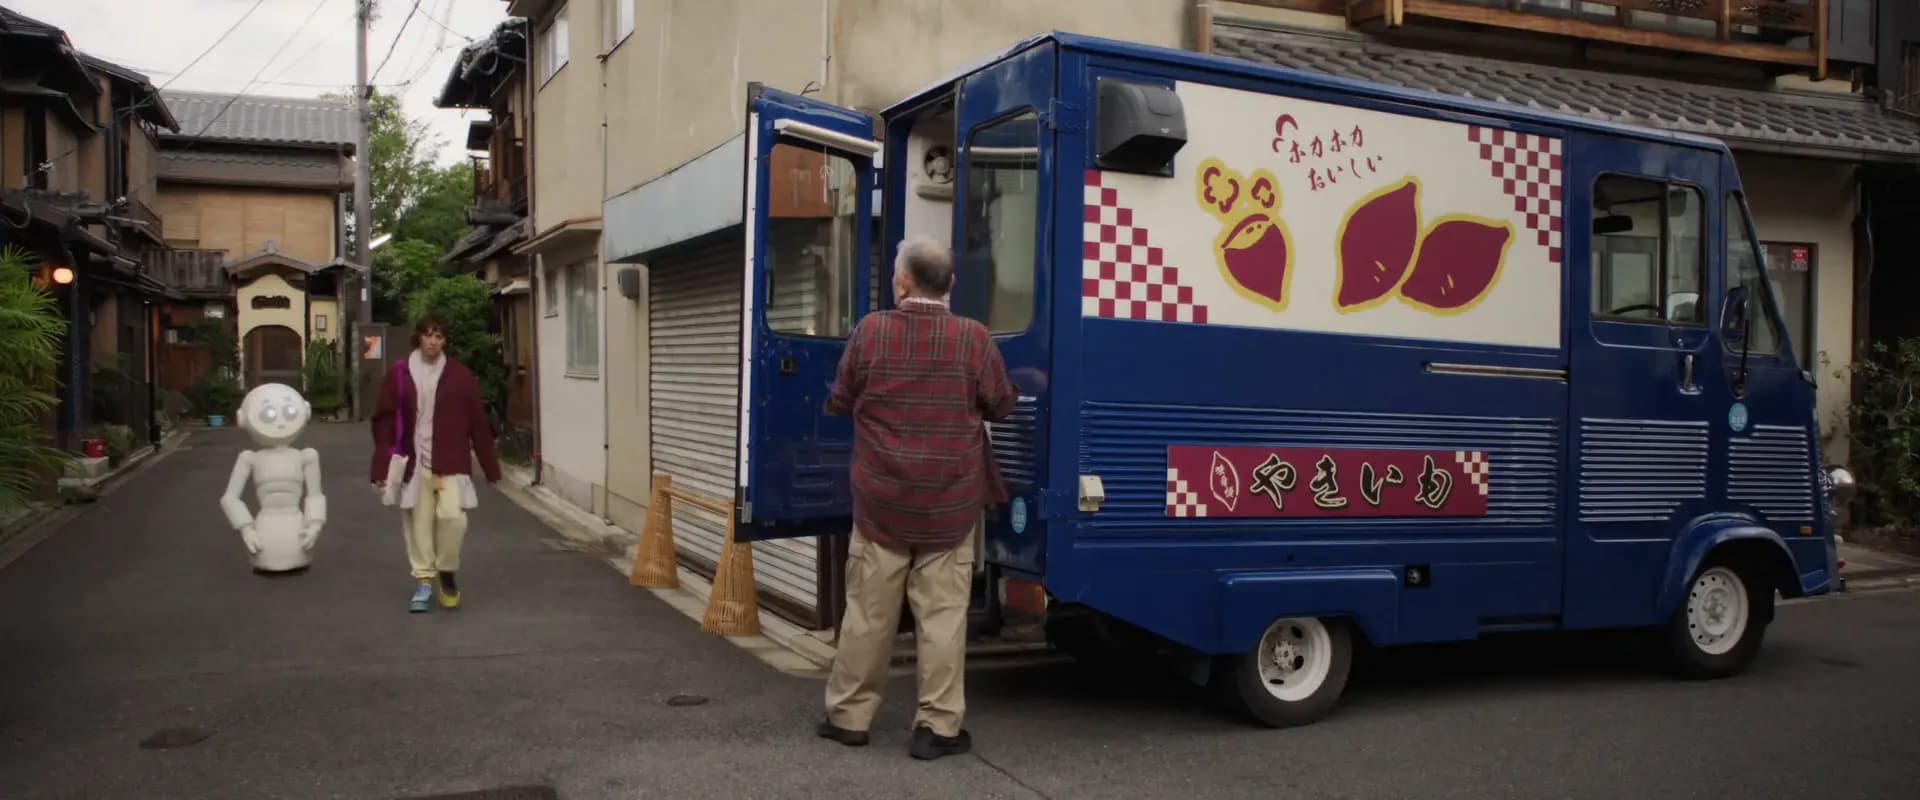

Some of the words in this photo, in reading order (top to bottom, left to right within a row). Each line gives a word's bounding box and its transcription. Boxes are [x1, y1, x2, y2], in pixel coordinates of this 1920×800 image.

[1289, 125, 1363, 163] ホカホカ
[1308, 156, 1383, 191] おいしい
[1250, 453, 1452, 508] やきいも
